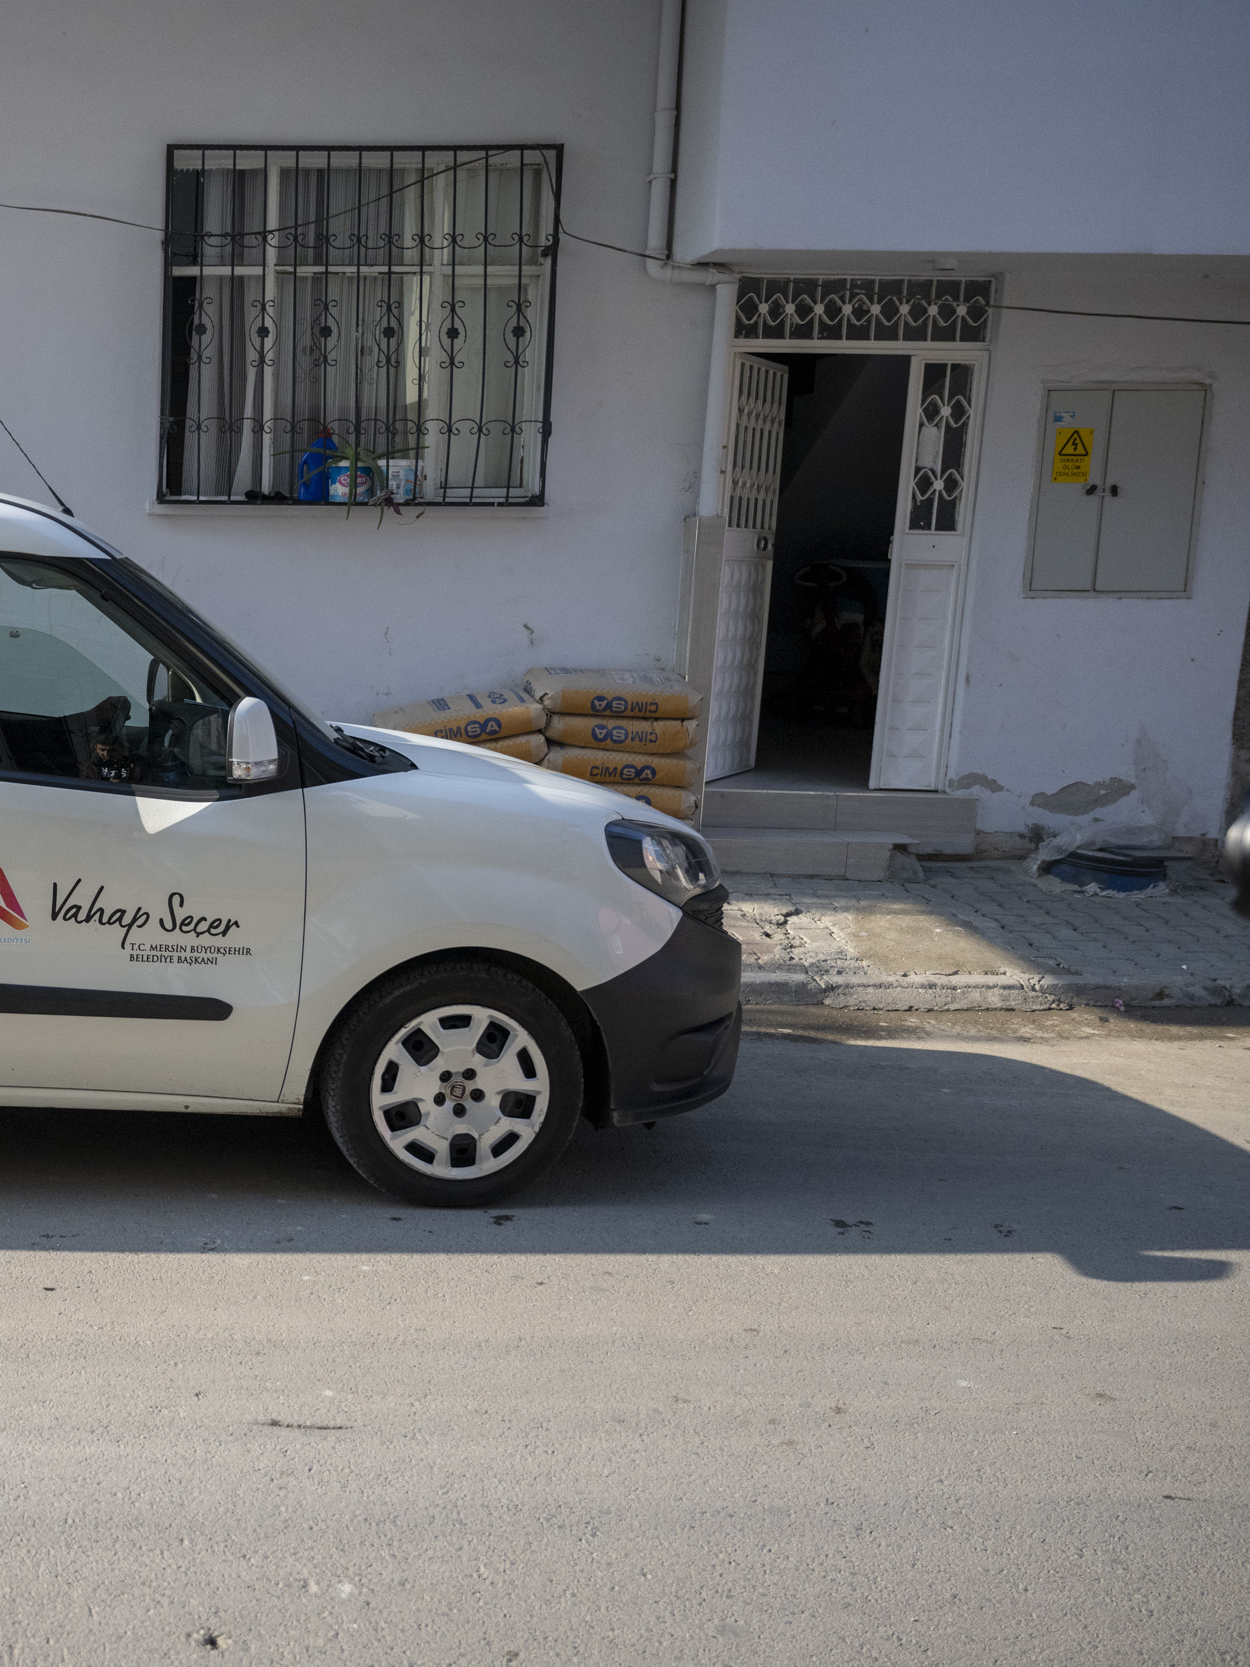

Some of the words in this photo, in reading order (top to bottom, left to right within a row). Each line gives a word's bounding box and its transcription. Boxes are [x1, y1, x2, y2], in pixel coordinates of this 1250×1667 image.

[51, 878, 150, 950] Vahap
[159, 892, 241, 938] Seçer
[129, 943, 147, 952] T.C.
[149, 943, 187, 953] MERSİN
[190, 944, 252, 957] BÜYÜKŞEHİR
[129, 954, 174, 964] BELEDİYE
[177, 955, 218, 967] BAŞKANI
